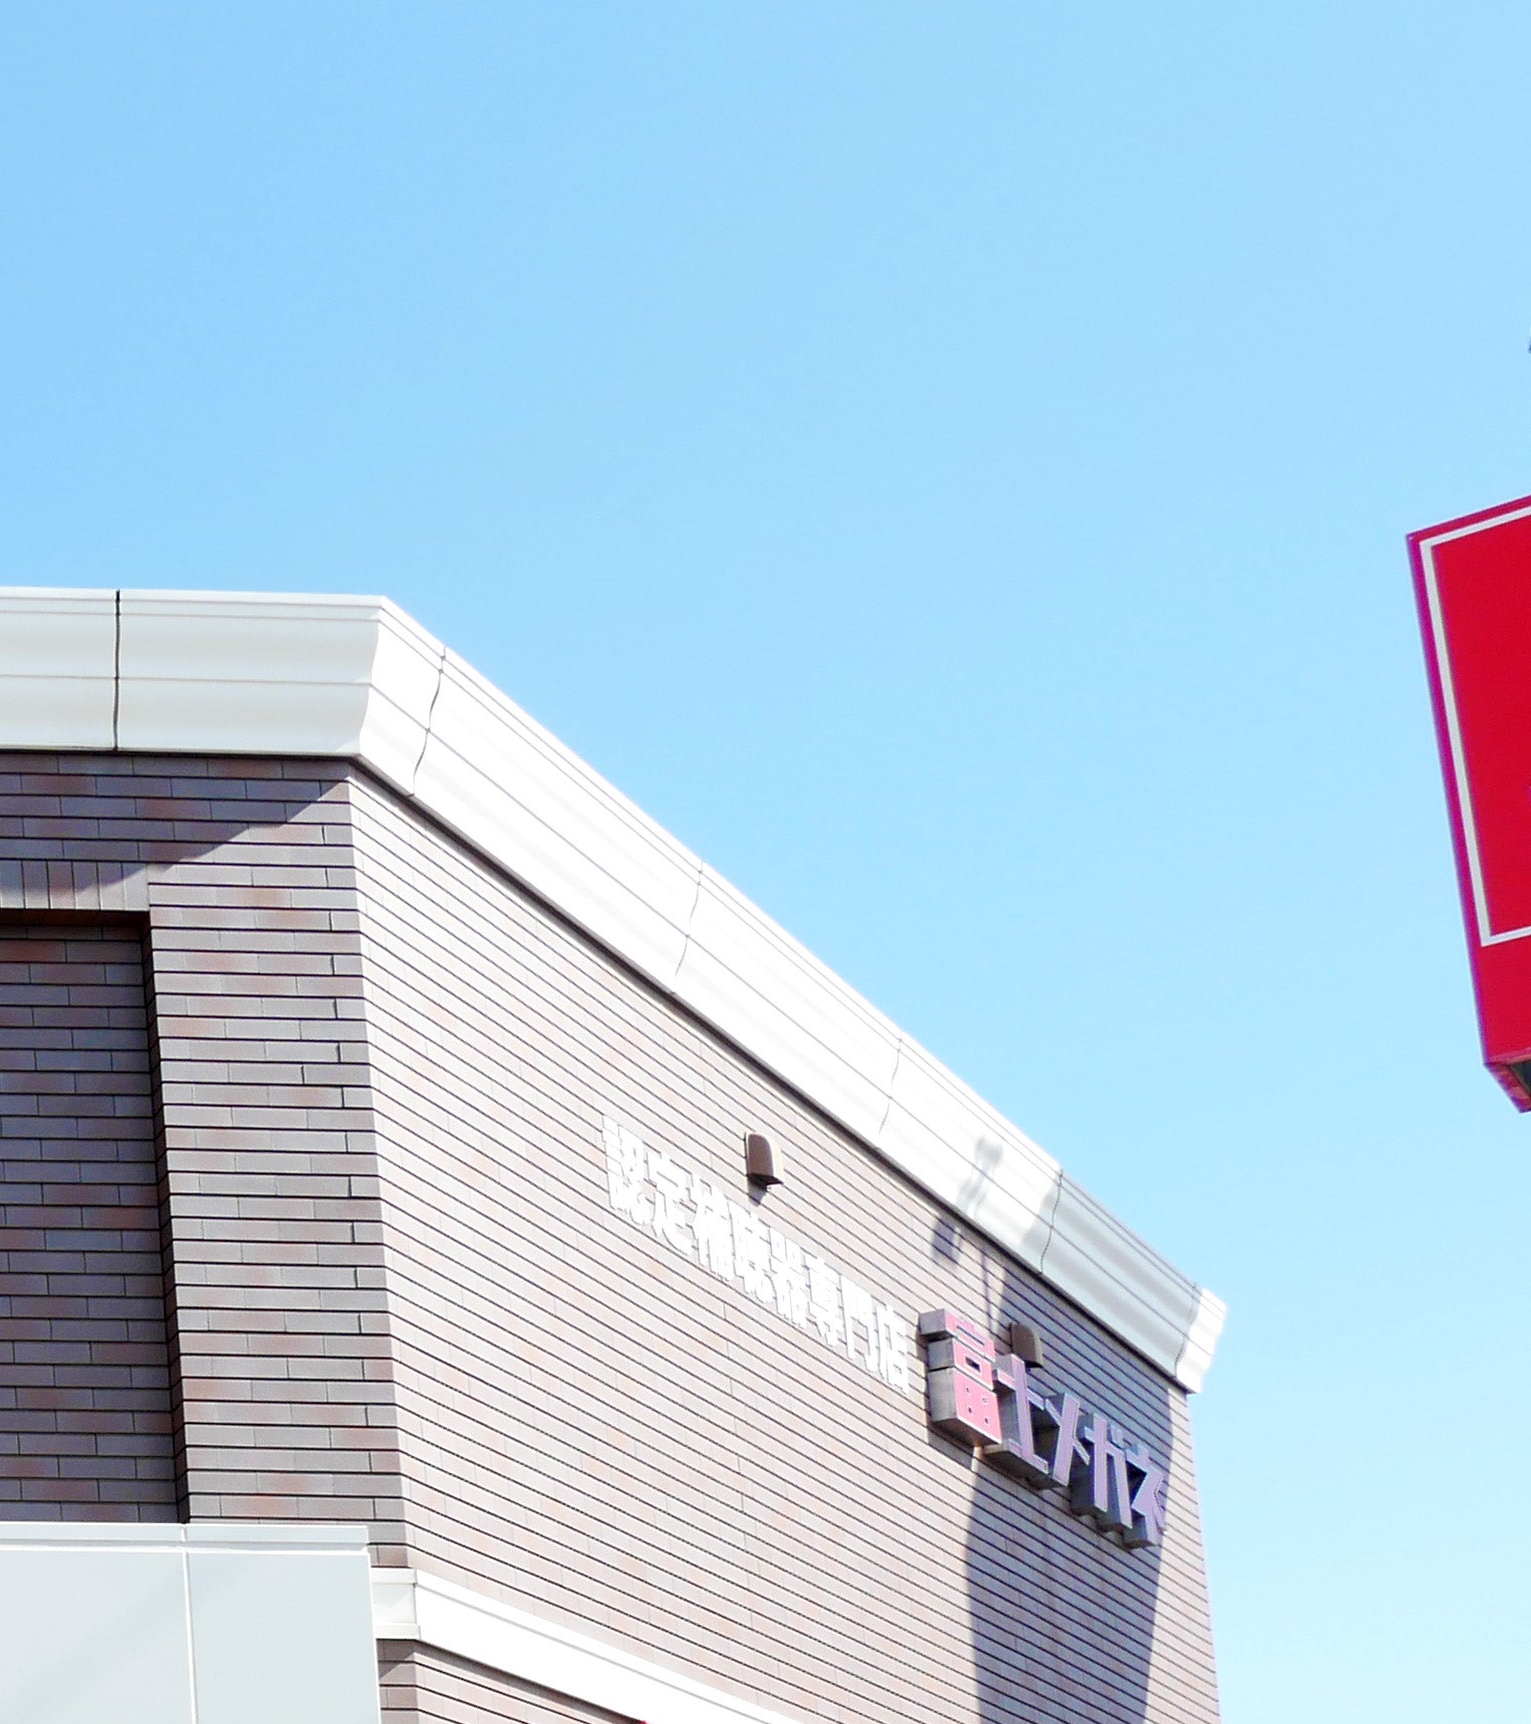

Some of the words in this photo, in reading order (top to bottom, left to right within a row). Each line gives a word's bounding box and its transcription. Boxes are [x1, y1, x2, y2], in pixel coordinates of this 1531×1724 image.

[941, 1309, 1167, 1548] 富士メガネ
